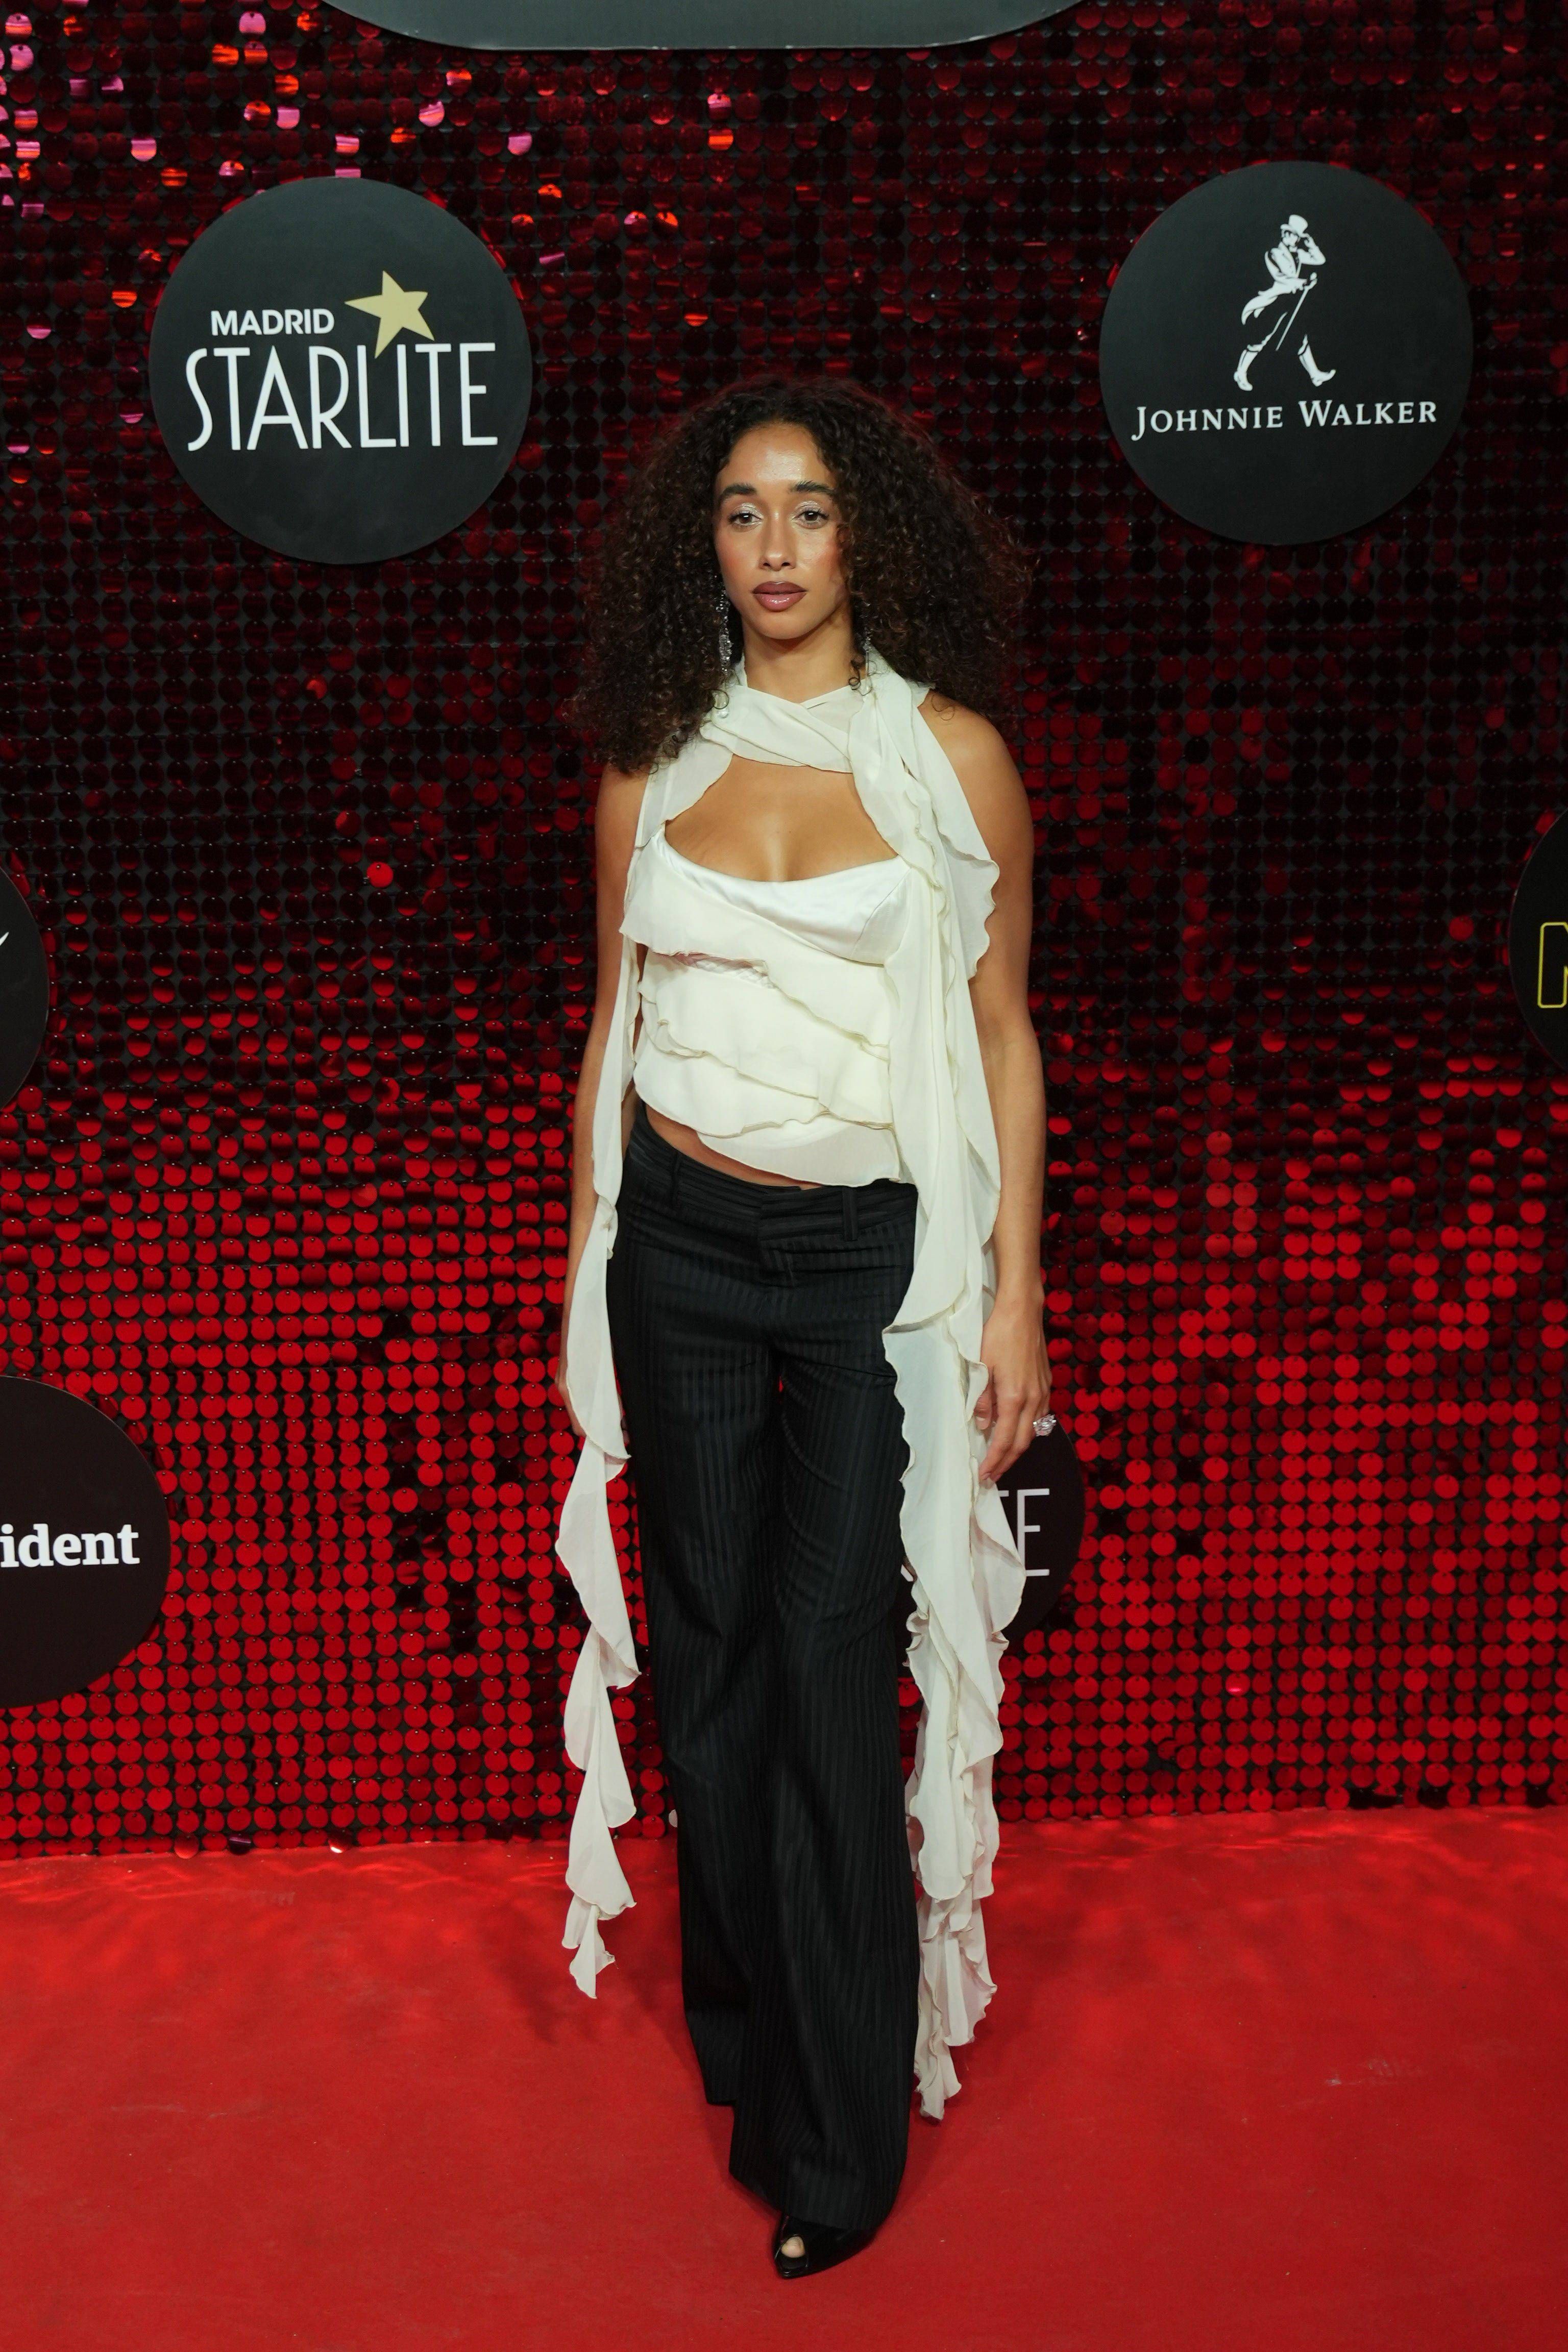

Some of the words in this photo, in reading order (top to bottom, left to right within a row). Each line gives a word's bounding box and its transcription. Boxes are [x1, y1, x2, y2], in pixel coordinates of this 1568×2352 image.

[210, 308, 335, 336] MADRID
[185, 342, 499, 452] STARLITE
[1131, 406, 1283, 442] JOHNNIE
[1298, 399, 1437, 428] WALKER
